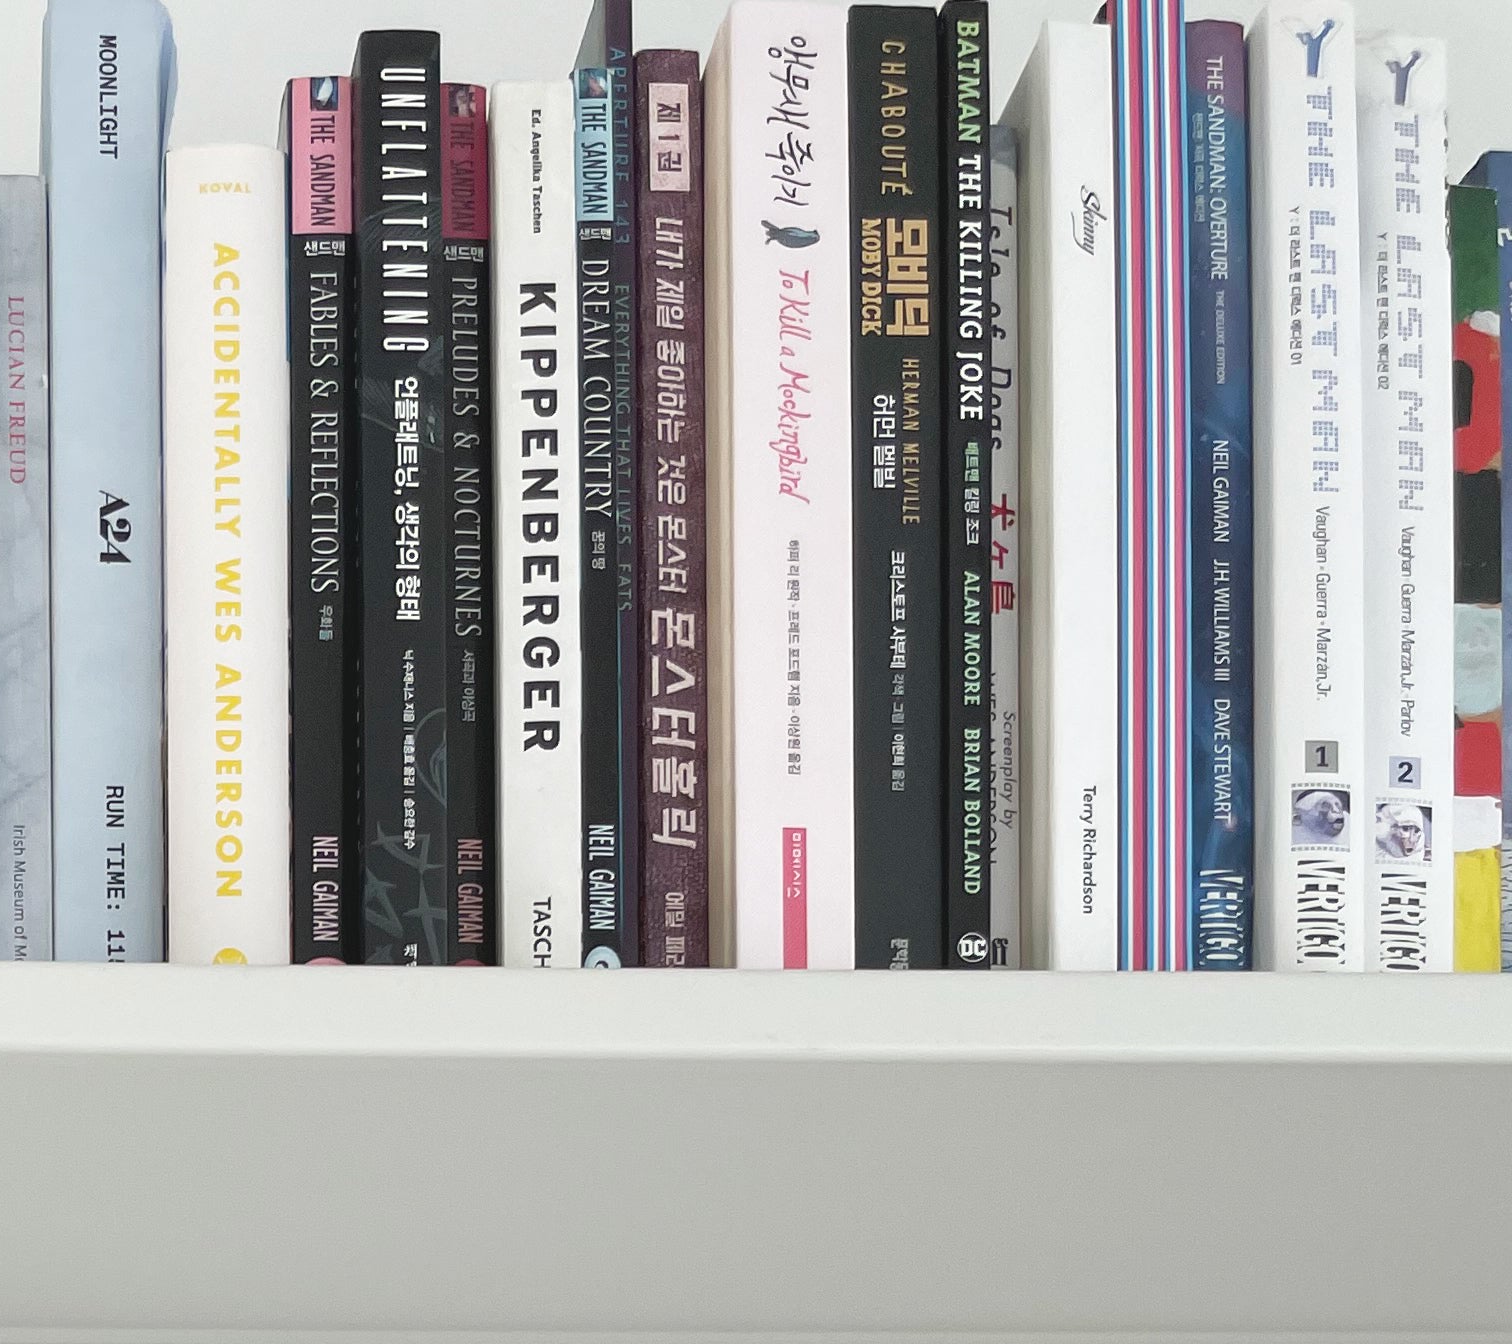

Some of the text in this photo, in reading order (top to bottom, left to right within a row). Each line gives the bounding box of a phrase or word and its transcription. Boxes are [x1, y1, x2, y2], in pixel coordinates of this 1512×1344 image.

[96, 35, 119, 159] MOONLIGHT
[309, 115, 337, 227] THE SANDMAN
[526, 109, 544, 234] Ed. Angelika Taschen
[879, 41, 912, 195] CHABOUTÉ
[1204, 56, 1228, 279] THE SANDMAN: OVERTURE
[379, 67, 430, 351] UNFLATTENING
[861, 218, 883, 335] MOBY DICK
[885, 218, 929, 335] 모비딕
[956, 20, 985, 421] BATMAN THE KILLING JOKE
[1306, 87, 1340, 493] THE LAST MAN
[5, 296, 29, 484] LUCIAN FREUD
[308, 273, 340, 593] FABLES & REFLECTIONS
[451, 277, 483, 638] PRELUDES & NOCTURNES
[580, 259, 613, 518] DREAM COUNTRY
[768, 270, 811, 504] To Kill a Mockingbird
[872, 395, 896, 489] 허먼 멜빌
[900, 358, 921, 524] HERMAN MELVILLE
[96, 490, 132, 564] A24
[395, 502, 422, 569] 생각의
[519, 283, 560, 751] KIPPENBERGER
[650, 217, 697, 850] 내가 제일 좋아하는 것은 몬스터 몬스터홀릭
[1210, 441, 1231, 541] NEIL GAIMAN
[213, 243, 244, 898] ACCIDENTALLY WES ANDERSON
[395, 576, 422, 620] 형태
[963, 570, 983, 706] ALAN MOORE
[964, 728, 983, 895] BRIAN BOLLAND
[1212, 699, 1233, 822] DAVE STEWART
[312, 836, 340, 941] NEIL GAIMAN
[1079, 786, 1097, 914] Terry Richardson
